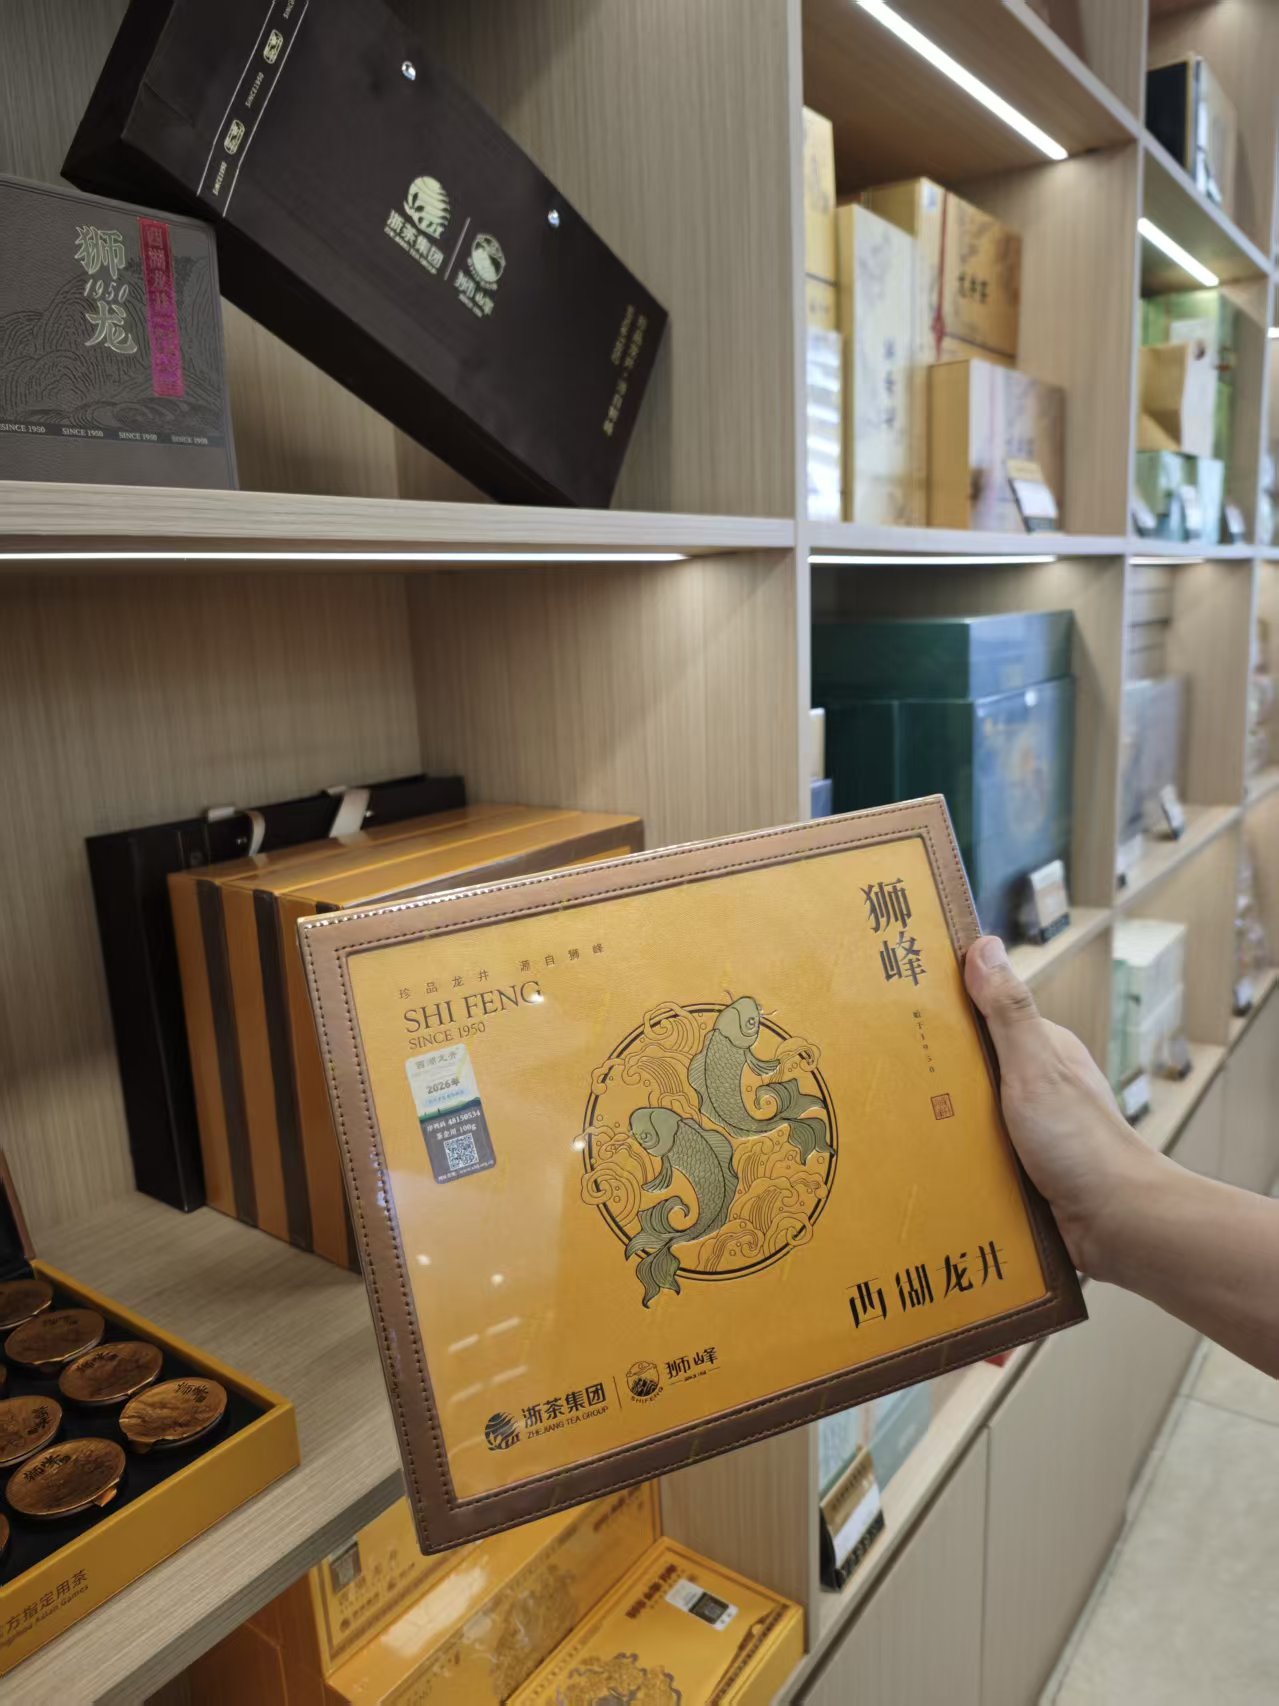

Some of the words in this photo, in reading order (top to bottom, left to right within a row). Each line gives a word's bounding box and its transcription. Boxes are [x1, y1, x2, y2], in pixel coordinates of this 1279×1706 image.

[84, 279, 129, 303] 1950
[0, 423, 27, 433] SINCE
[28, 425, 46, 434] 1950
[62, 427, 86, 437] SINCE
[87, 428, 104, 438] 1950
[119, 431, 141, 441] SINCE
[860, 877, 927, 986] 狮峰
[400, 969, 489, 999] 珍品龙井
[403, 1000, 457, 1034] SHI
[463, 980, 545, 1020] FENG
[408, 1029, 454, 1051] SINCE
[457, 1021, 486, 1040] 1950
[846, 1240, 1008, 1329] 西湖龙井
[664, 1347, 719, 1380] 狮峰
[521, 1382, 607, 1429] 浙茶集团
[527, 1420, 565, 1439] ZHEJIANG
[566, 1415, 582, 1426] TEA
[582, 1405, 609, 1421] GROUP
